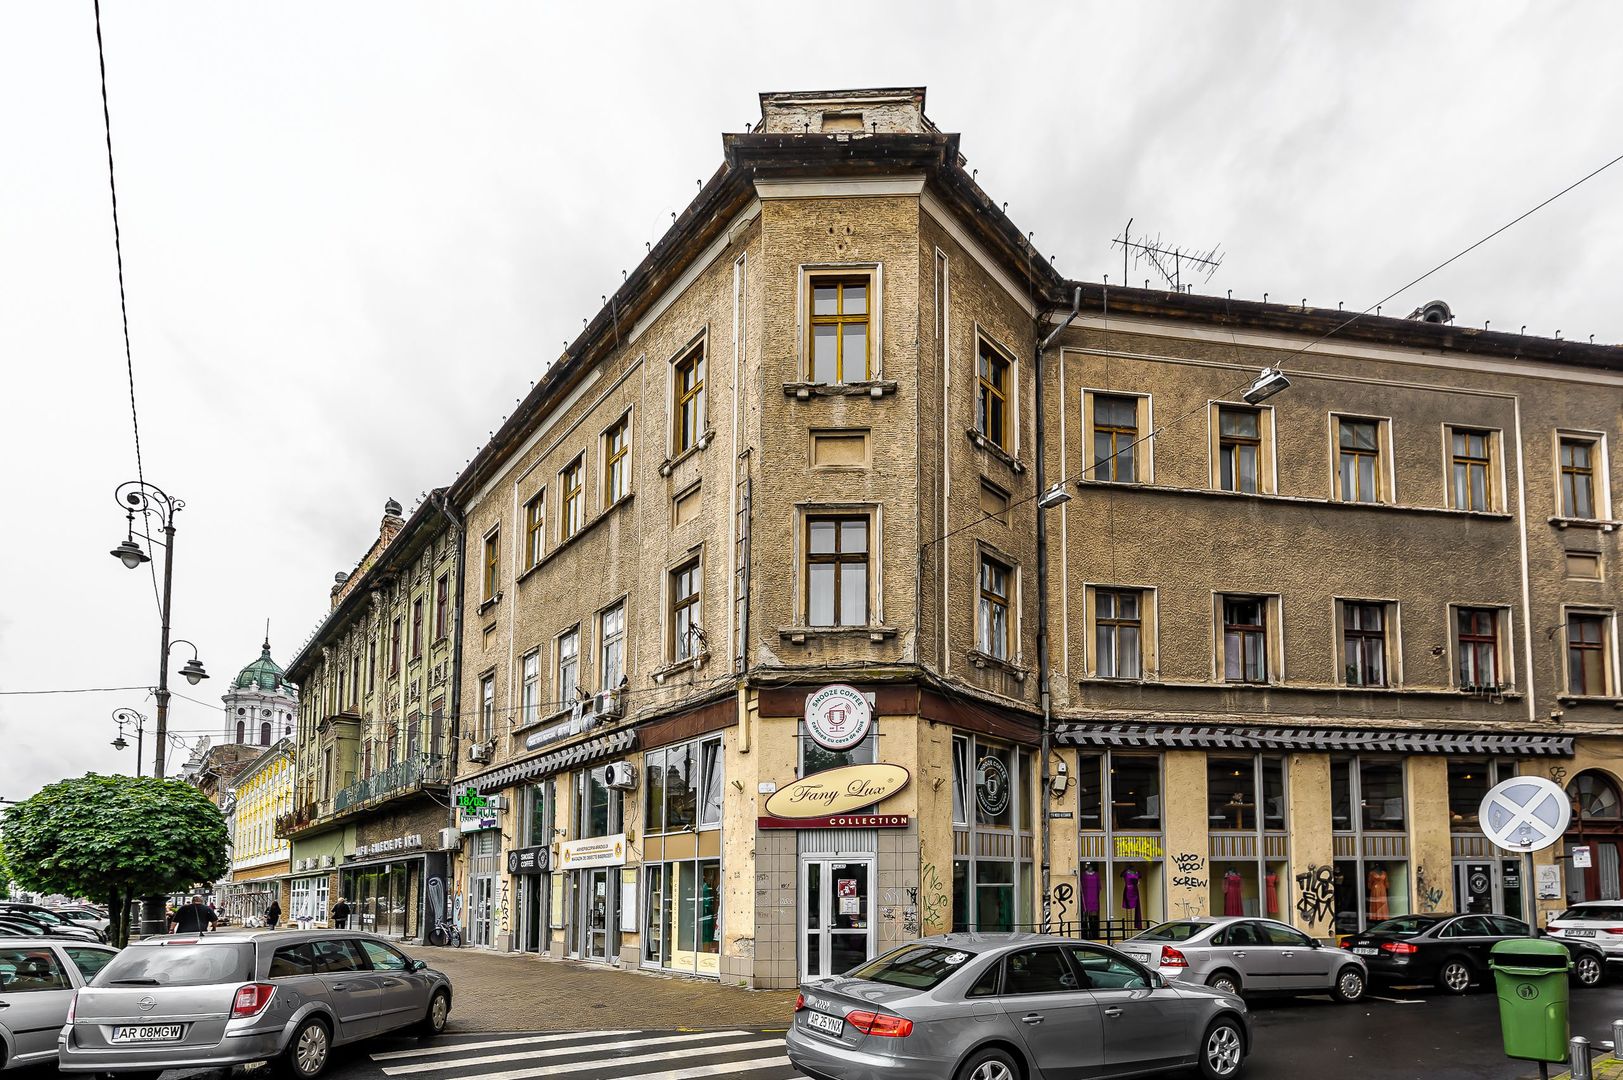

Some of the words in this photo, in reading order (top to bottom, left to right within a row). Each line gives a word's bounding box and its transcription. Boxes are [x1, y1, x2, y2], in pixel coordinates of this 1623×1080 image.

[812, 689, 838, 707] SNOOZE
[840, 689, 863, 706] COFFEE
[811, 721, 827, 740] cafenea
[855, 721, 865, 733] spus
[789, 783, 840, 806] Fany
[844, 779, 886, 797] Lux
[829, 817, 907, 825] COLLECTION
[520, 860, 534, 868] COFFEE
[1171, 852, 1198, 864] WOO
[1172, 876, 1208, 888] SCREW
[811, 1013, 819, 1025] AR
[820, 1016, 828, 1028] 25
[828, 1018, 842, 1032] YNX
[119, 1028, 137, 1038] AR
